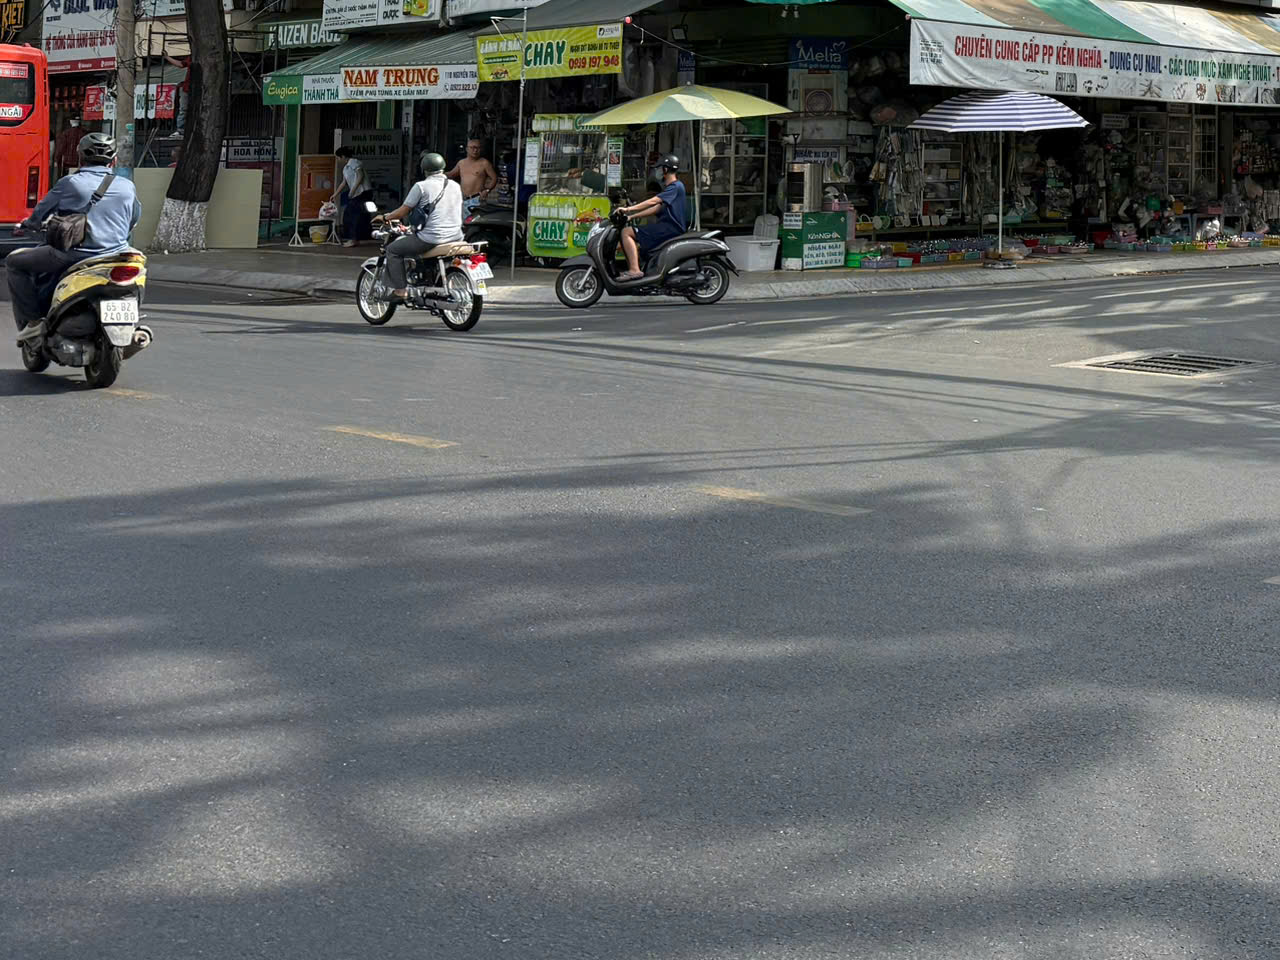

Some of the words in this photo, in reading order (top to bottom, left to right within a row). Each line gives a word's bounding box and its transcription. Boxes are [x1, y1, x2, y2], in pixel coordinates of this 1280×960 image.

[269, 23, 309, 47] KAIZEN
[525, 40, 567, 67] CHAY
[799, 46, 842, 63] Melia
[955, 34, 993, 59] CHUYÊN
[995, 40, 1020, 61] CUNG
[1022, 36, 1040, 63] CẤP
[1042, 44, 1054, 64] PP
[1056, 40, 1075, 67] KỀM
[1077, 46, 1102, 69] NGHĨA
[1109, 51, 1131, 74] DỤNG
[1133, 53, 1144, 76] CỤ
[1145, 55, 1162, 74] NAIL
[1169, 56, 1183, 76] CÁC
[1234, 61, 1251, 84] NGHỆ
[343, 69, 379, 87] NAM
[383, 67, 440, 86] TRUNG
[267, 82, 299, 99] Eugica
[304, 86, 326, 101] THÀNH
[326, 85, 339, 100] THÁ
[234, 148, 253, 157] HOA
[533, 222, 567, 242] CHAY
